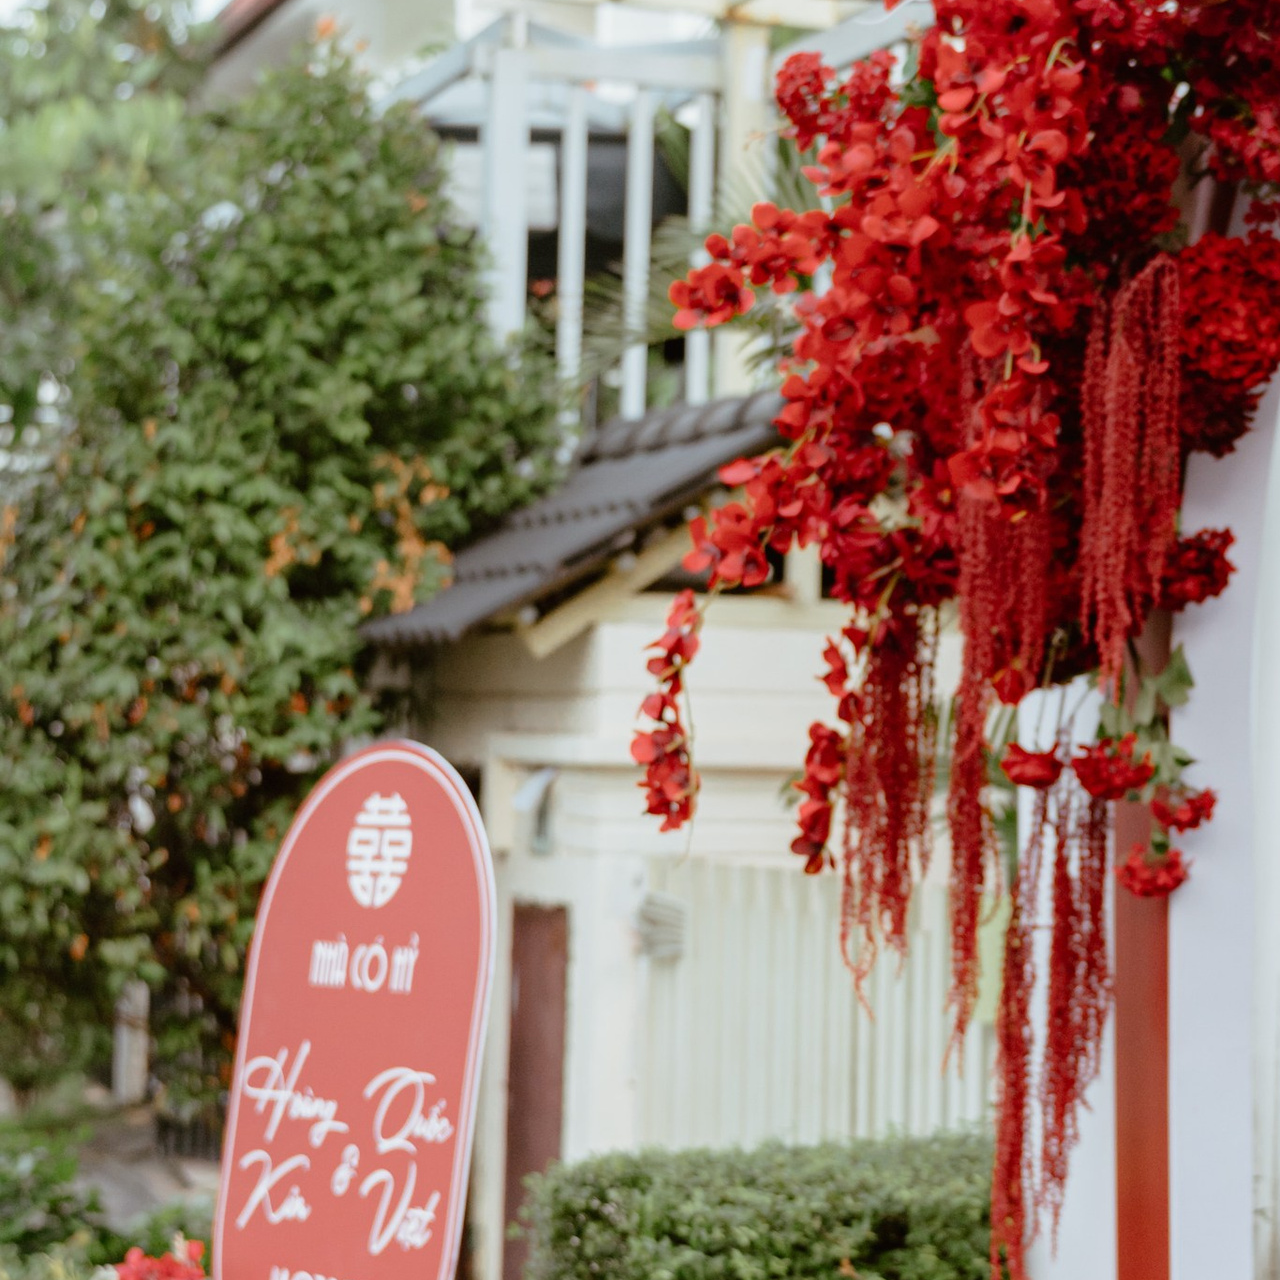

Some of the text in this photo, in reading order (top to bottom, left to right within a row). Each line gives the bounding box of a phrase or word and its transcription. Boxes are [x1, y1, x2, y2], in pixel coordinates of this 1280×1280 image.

[308, 932, 349, 989] NHÀ
[350, 934, 389, 993] CÓ
[331, 1144, 360, 1196] &
[358, 1160, 441, 1256] Việt
